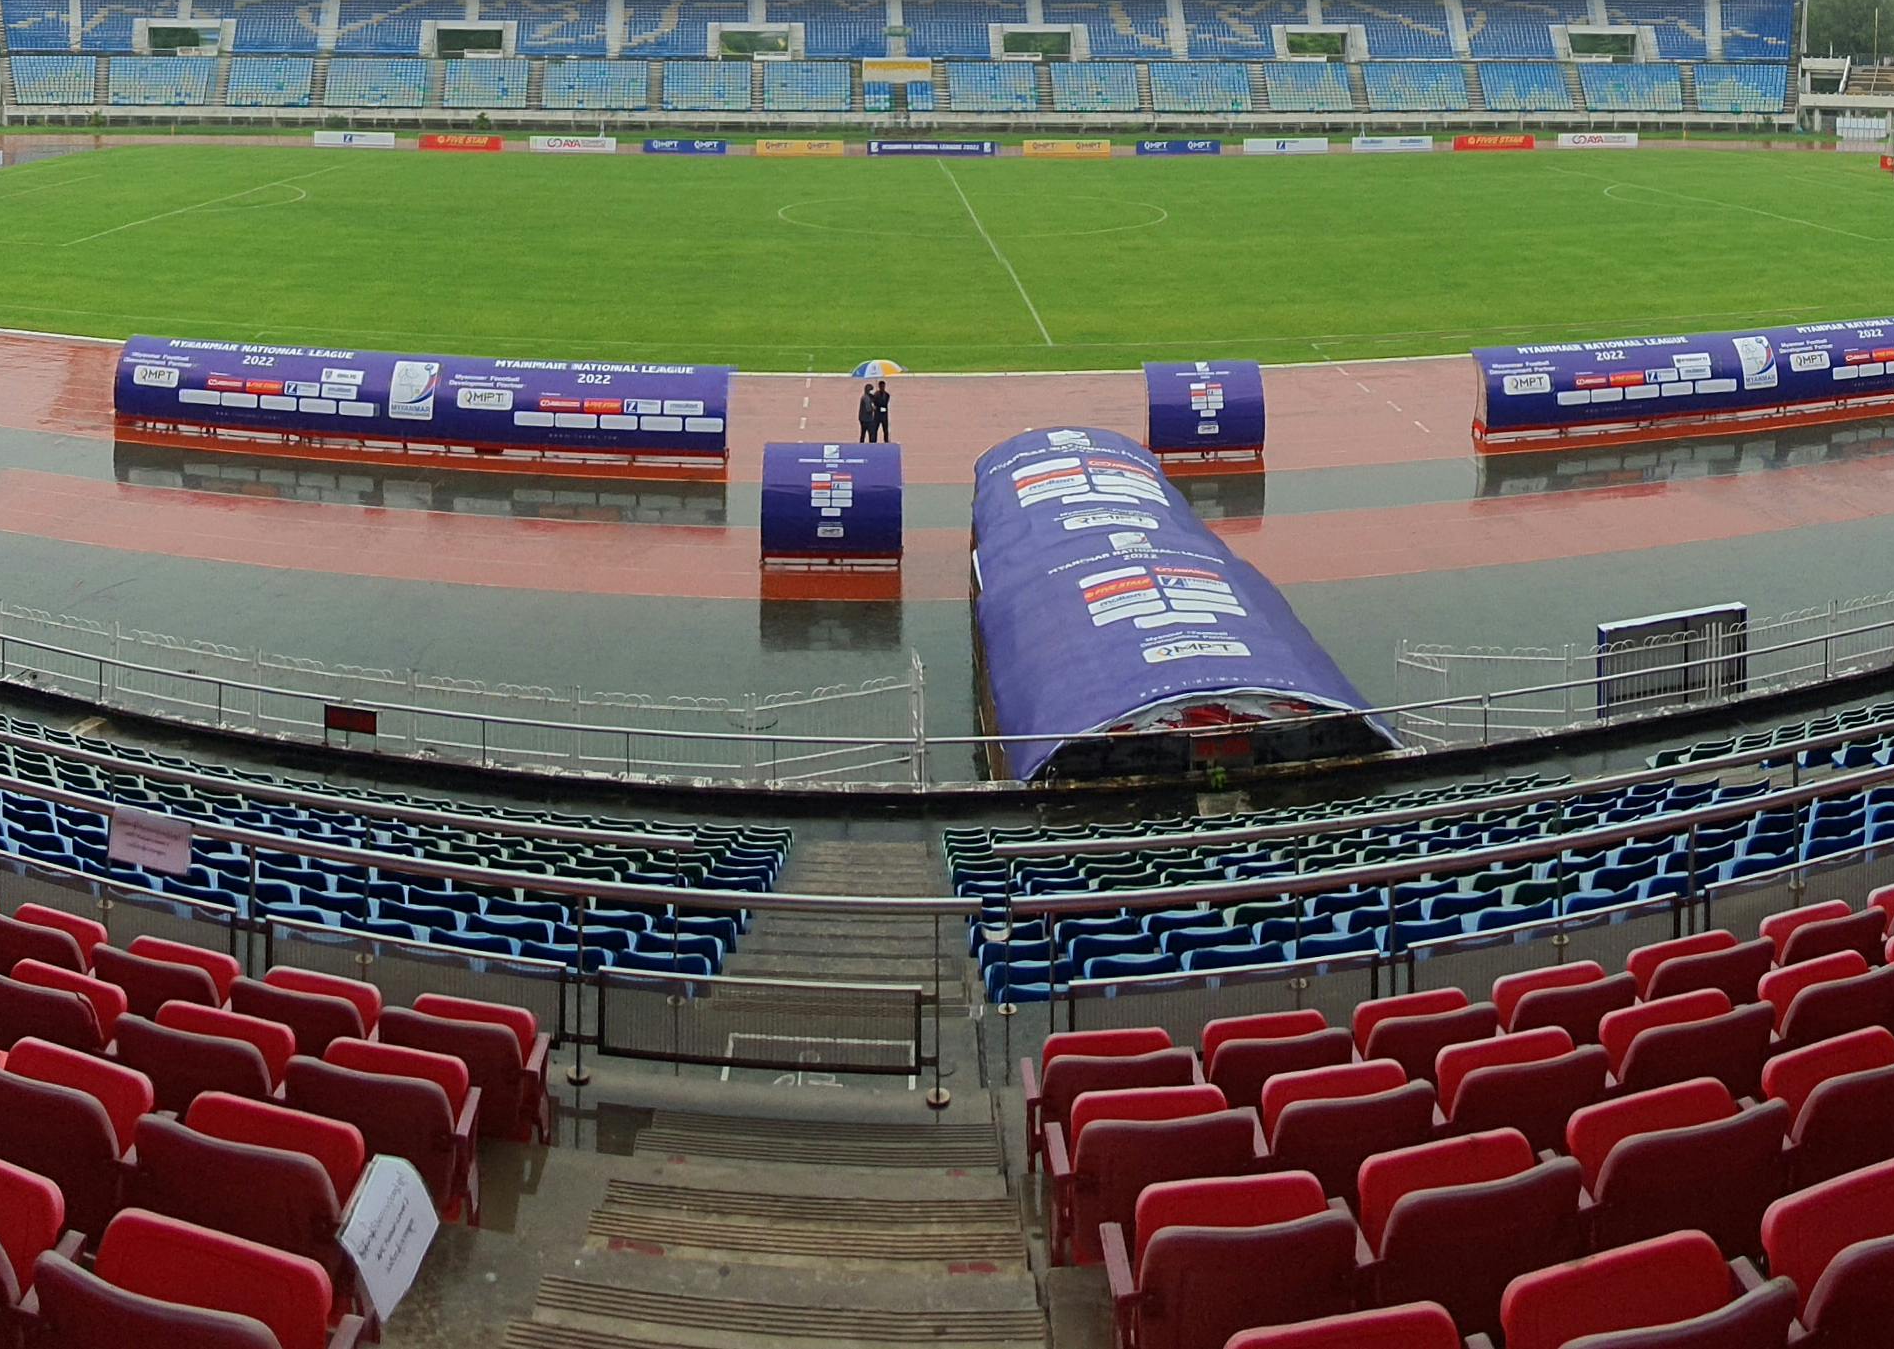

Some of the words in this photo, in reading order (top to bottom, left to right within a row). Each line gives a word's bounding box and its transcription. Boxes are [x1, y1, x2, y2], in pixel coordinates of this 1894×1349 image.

[1858, 329, 1884, 339] 2022
[308, 349, 354, 359] LEAGUE
[1595, 350, 1626, 361] 2022
[242, 355, 274, 367] 2022
[149, 369, 174, 381] MPT
[577, 373, 612, 385] 2022
[1520, 376, 1544, 387] MPT
[1175, 643, 1233, 653] MPT
